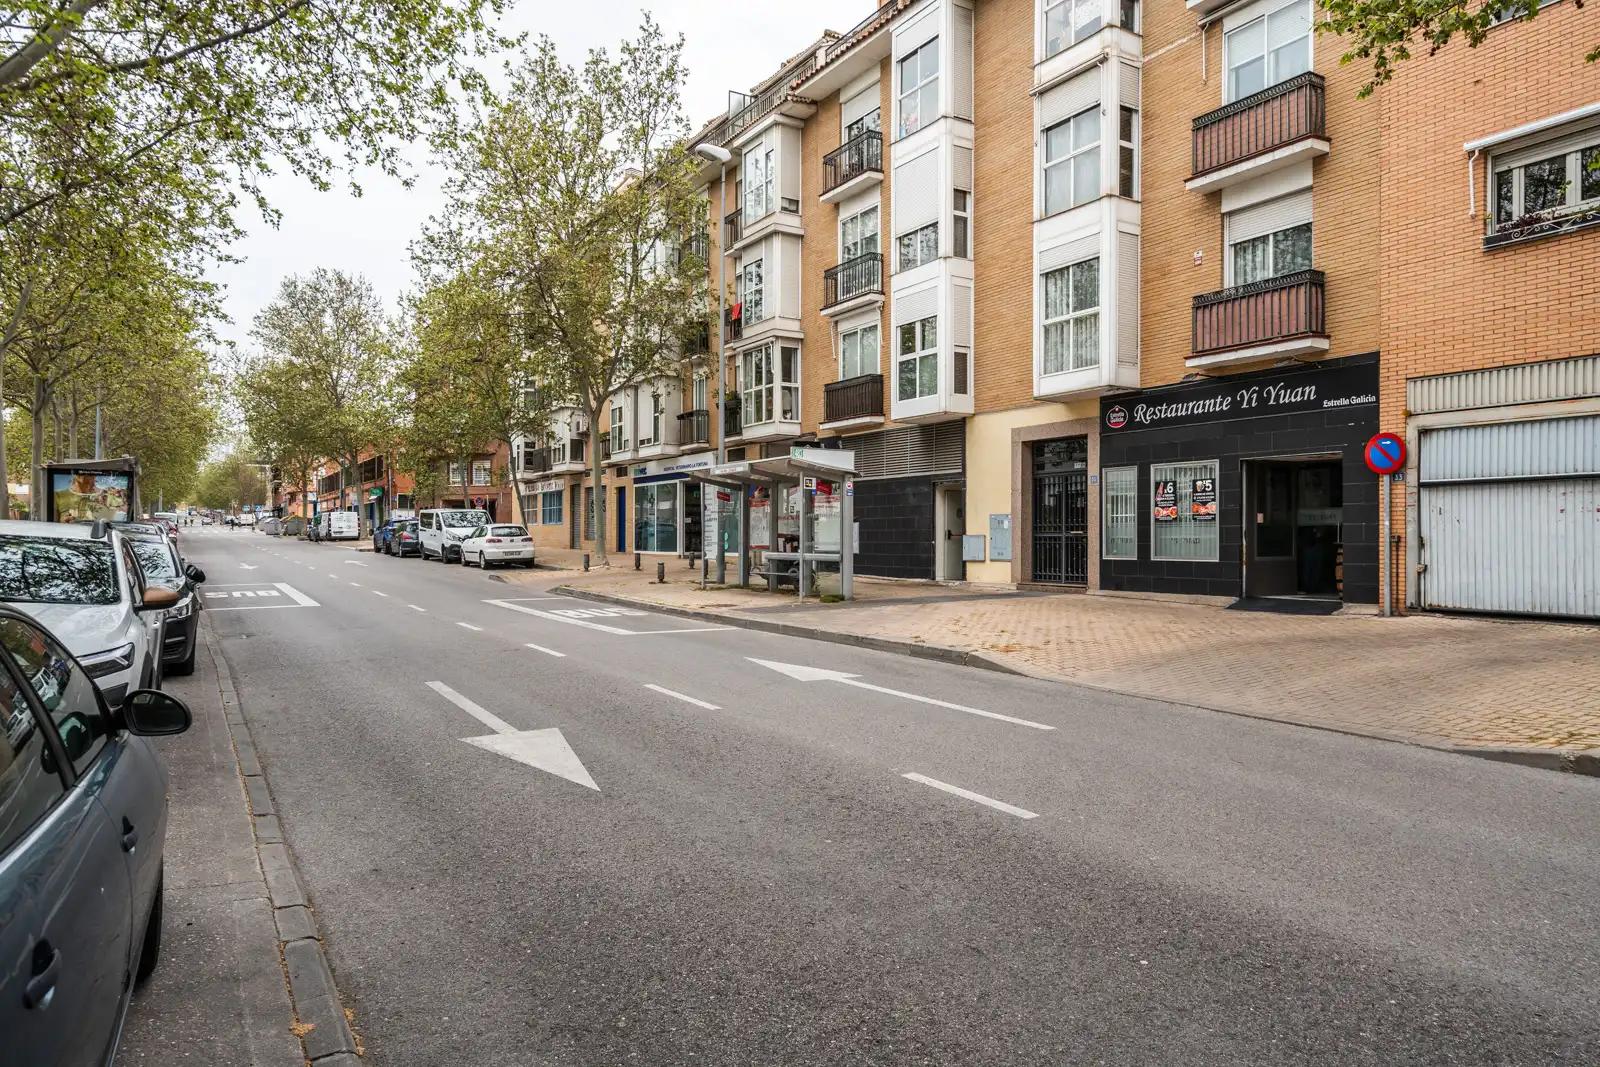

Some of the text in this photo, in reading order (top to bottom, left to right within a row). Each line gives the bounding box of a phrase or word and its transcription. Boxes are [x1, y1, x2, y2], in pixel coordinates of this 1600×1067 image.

[1133, 382, 1317, 424] Restaurante Yi Yuan
[1323, 395, 1376, 408] Estrella Galicia
[548, 607, 650, 618] BUS
